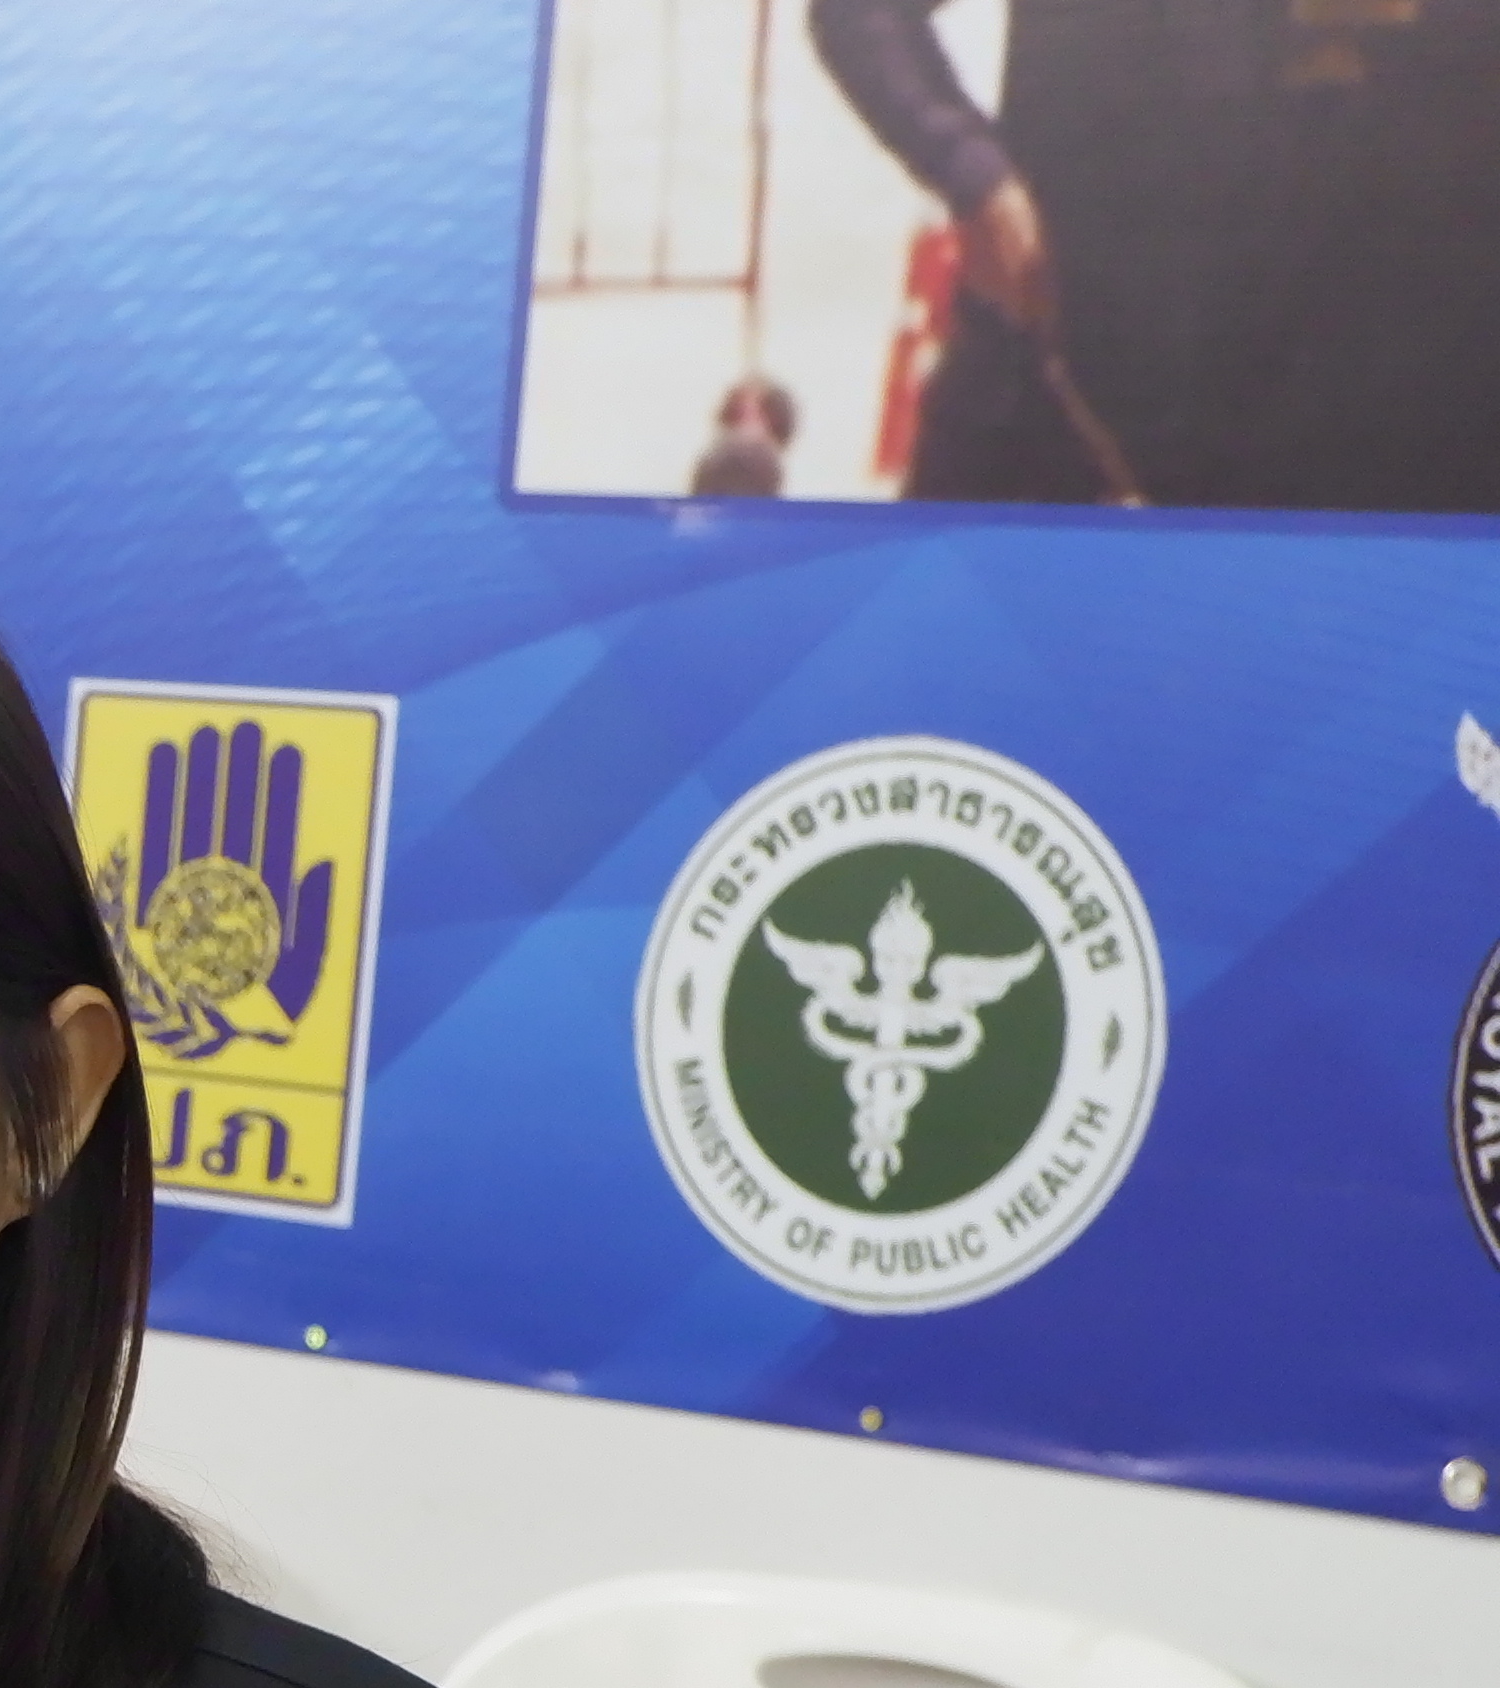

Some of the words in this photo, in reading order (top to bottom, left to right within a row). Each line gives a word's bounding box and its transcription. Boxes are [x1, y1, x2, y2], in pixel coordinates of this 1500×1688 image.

[673, 1057, 780, 1225] MINISTRY
[785, 1215, 835, 1258] OF
[848, 1226, 989, 1277] PUBLIC
[999, 1099, 1112, 1236] HEALTH
